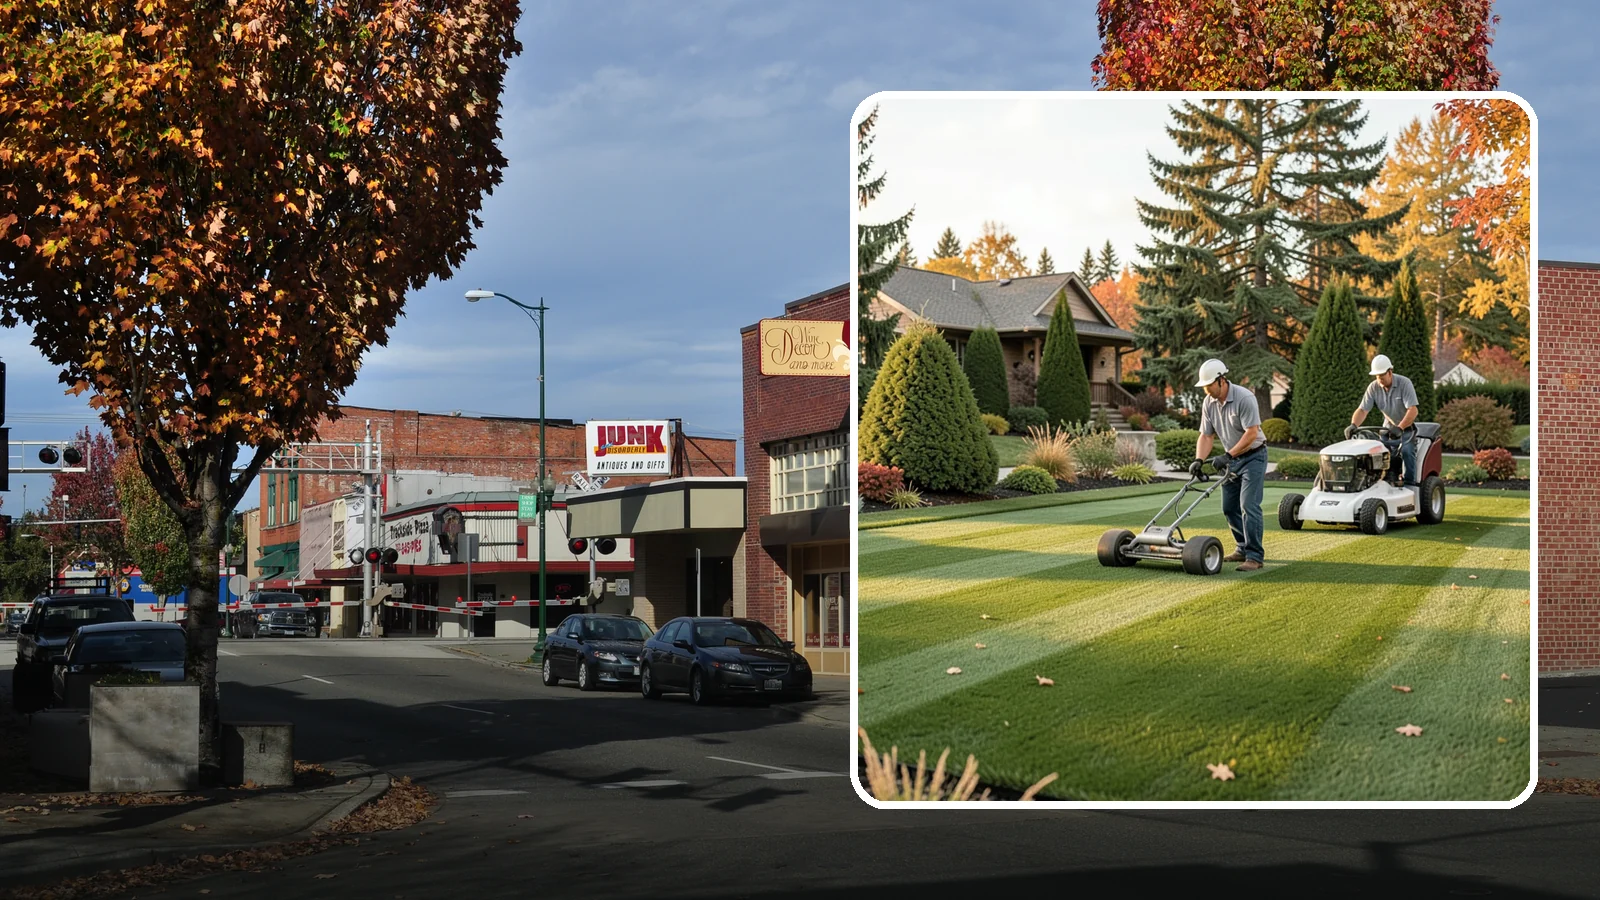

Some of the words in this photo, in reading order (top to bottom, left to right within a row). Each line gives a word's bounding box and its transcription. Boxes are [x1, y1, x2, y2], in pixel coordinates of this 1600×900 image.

[765, 328, 831, 365] Decor
[595, 425, 665, 457] JUNK
[607, 446, 646, 454] DISORDERLY
[597, 461, 628, 470] ANTIQUES
[631, 461, 644, 470] AND
[647, 460, 665, 470] GIFTS
[414, 519, 429, 535] Pizza
